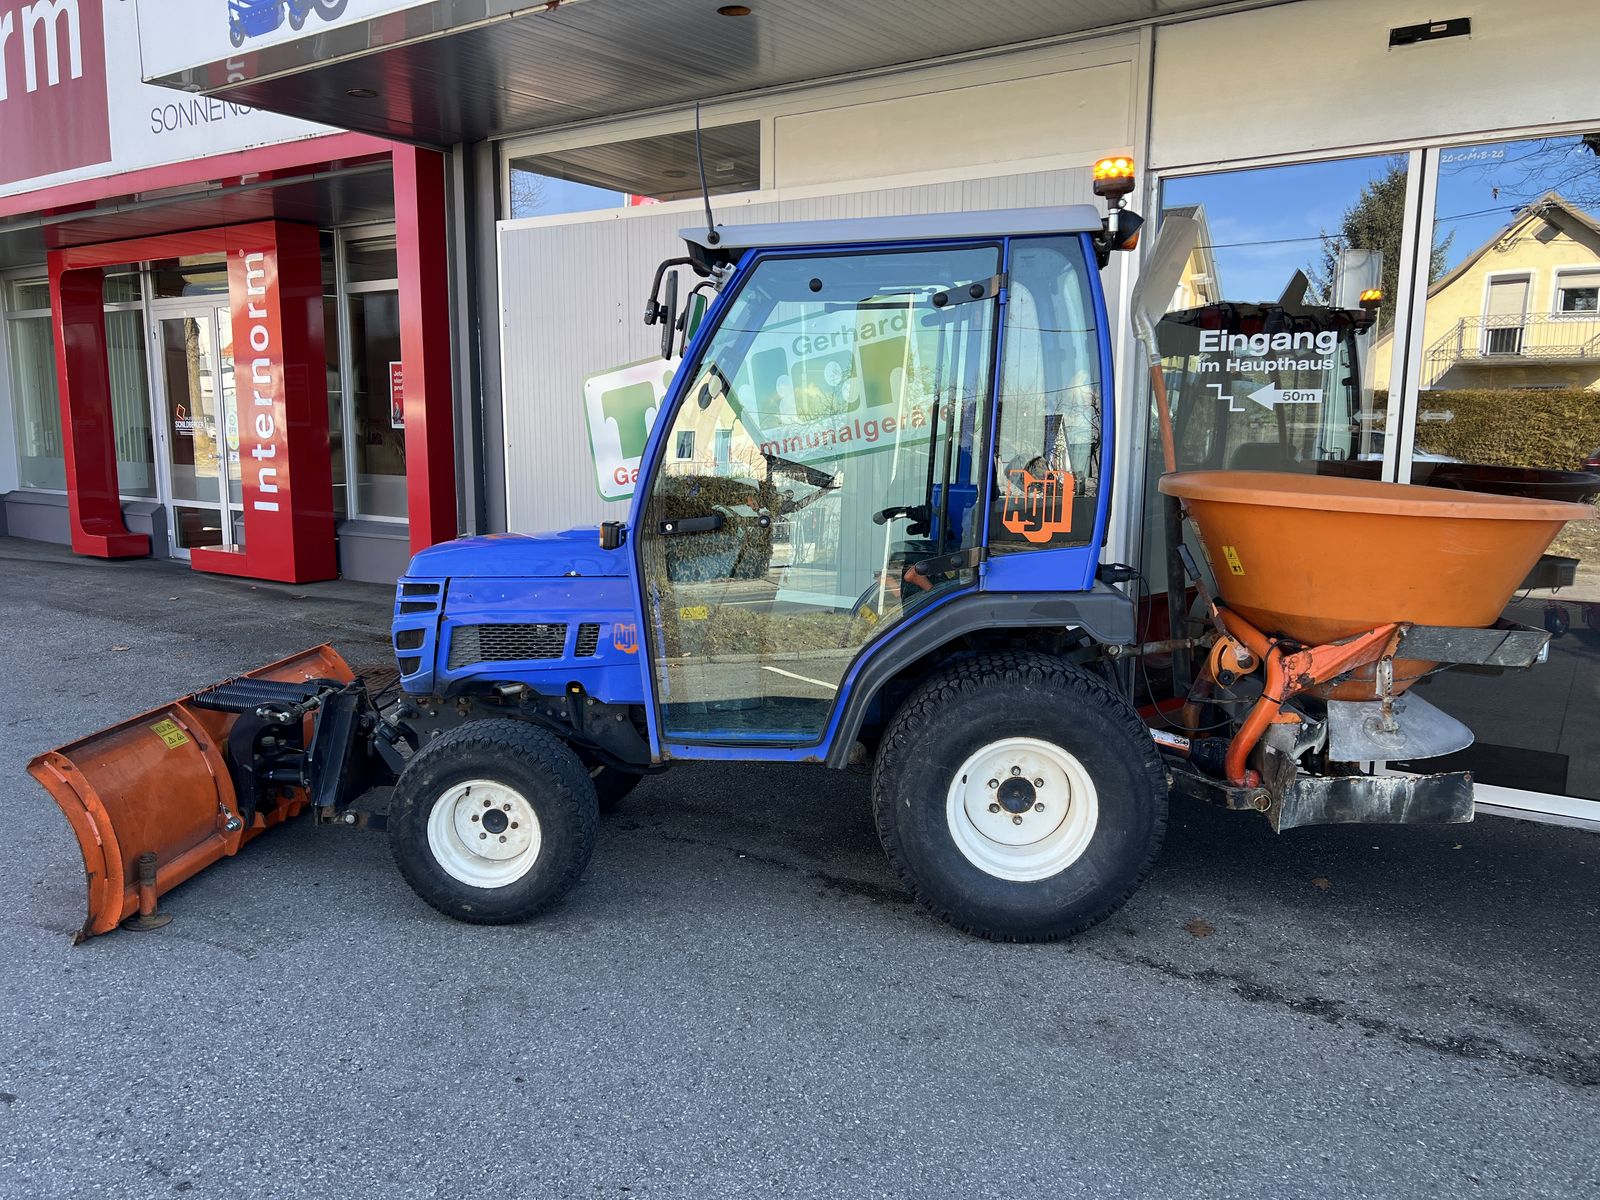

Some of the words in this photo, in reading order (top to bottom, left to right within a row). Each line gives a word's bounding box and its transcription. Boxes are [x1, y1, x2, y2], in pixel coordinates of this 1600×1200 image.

[792, 309, 909, 357] Gerhard
[1199, 329, 1338, 357] Eingang
[1197, 360, 1220, 373] im
[1226, 357, 1335, 375] Haupthaus
[247, 252, 280, 512] Internorm
[1282, 391, 1316, 402] 50m
